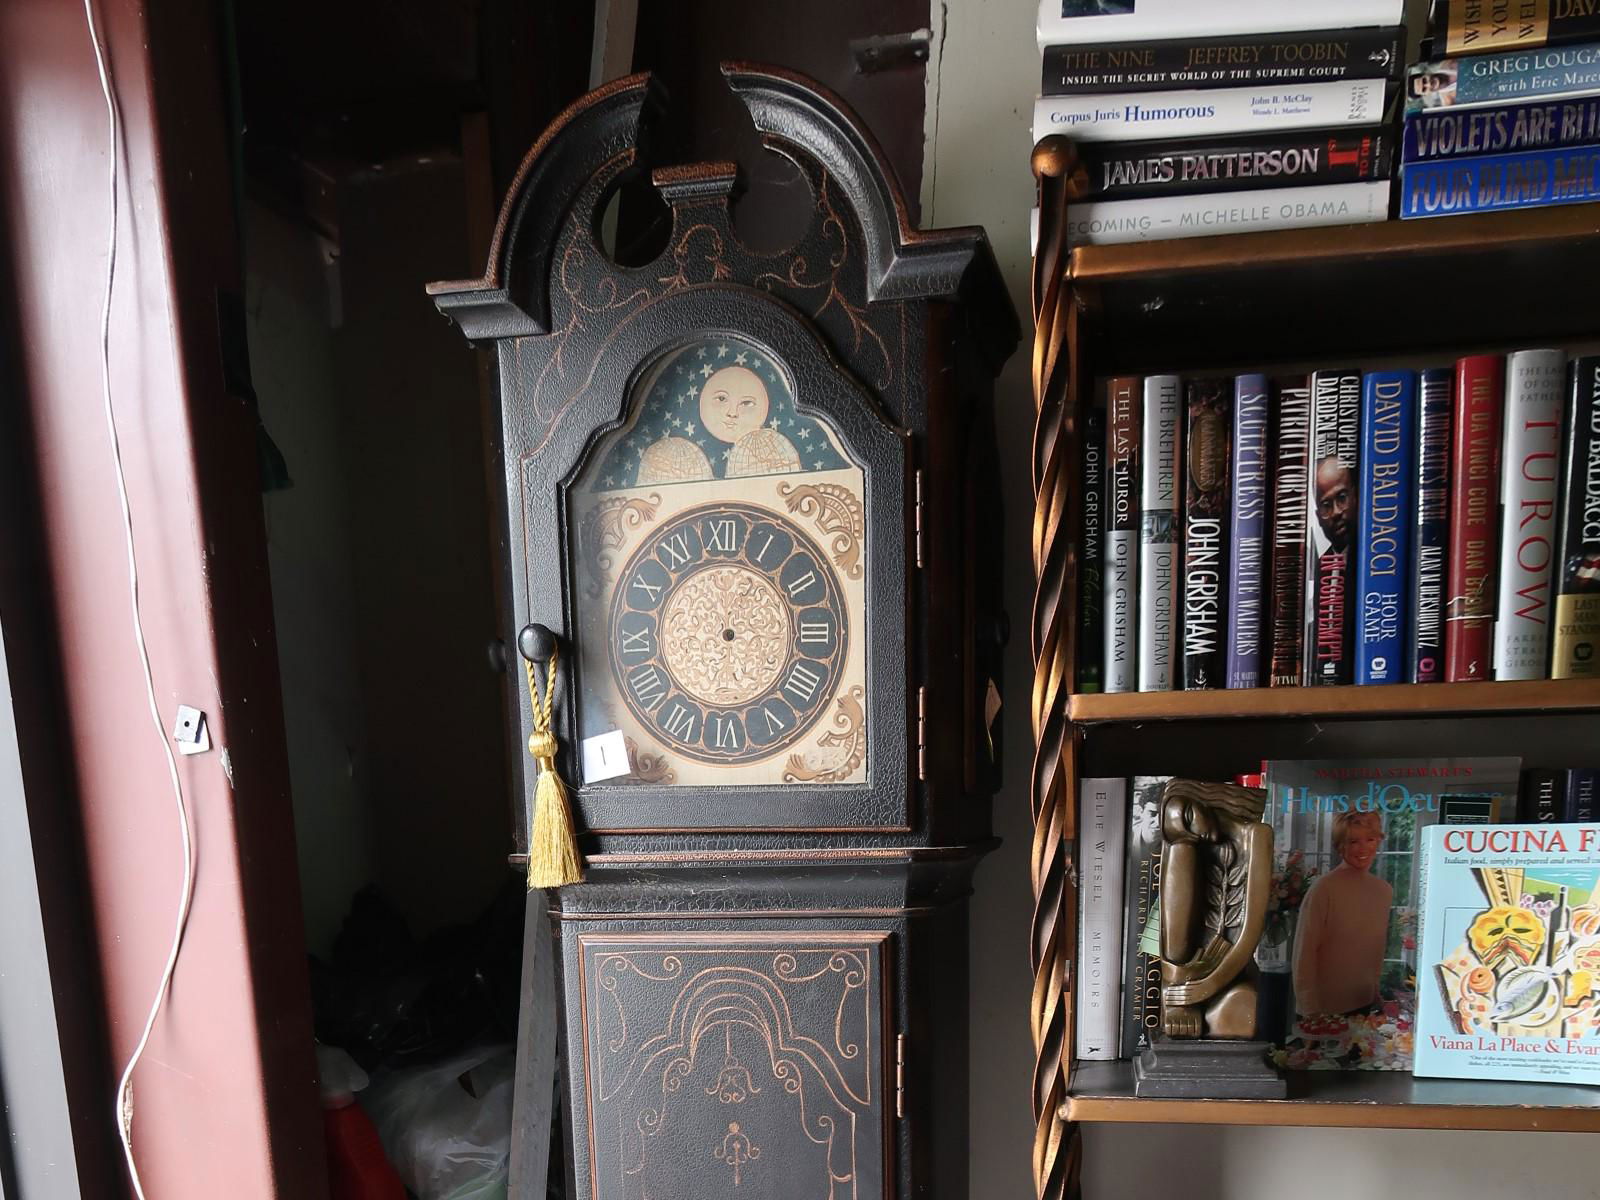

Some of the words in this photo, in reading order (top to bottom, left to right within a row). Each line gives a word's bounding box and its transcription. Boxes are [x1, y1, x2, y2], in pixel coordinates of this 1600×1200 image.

[1492, 0, 1508, 36] YOU
[1062, 52, 1100, 69] THE
[1107, 50, 1155, 69] NINE
[1184, 46, 1265, 70] JEFFREY
[1271, 42, 1348, 63] TOOBIN
[1062, 75, 1098, 85] INSIDE
[1103, 75, 1123, 83] THE
[1127, 73, 1166, 83] SECRET
[1170, 71, 1208, 81] WORLD
[1212, 70, 1226, 80] OF
[1229, 69, 1251, 78] THE
[1255, 67, 1305, 78] SUPREME
[1309, 66, 1346, 76] COURT
[1473, 59, 1528, 77] GREG
[1250, 96, 1270, 106] John
[1283, 94, 1313, 106] McClay
[1498, 79, 1527, 93] with
[1532, 75, 1558, 89] Eric
[1051, 111, 1091, 124] Corpus
[1093, 107, 1120, 123] Juris
[1124, 104, 1215, 123] Humorous
[1415, 112, 1508, 156] VIOLETS
[1511, 107, 1557, 147] ARE
[1102, 157, 1175, 191] JAMES
[1181, 147, 1320, 181] PATTERSON
[1411, 168, 1473, 213] FOUR
[1476, 160, 1549, 207] BLIND
[1068, 215, 1152, 234] ECOMING
[1180, 207, 1270, 227] MICHELLE
[1280, 201, 1349, 219] OBAMA
[1118, 387, 1131, 422] THE
[1160, 382, 1177, 414] THE
[1316, 376, 1339, 432] DARDEN
[1472, 377, 1491, 405] THE
[1279, 388, 1311, 460] PATRICIA
[1337, 376, 1360, 469] CHRISTOPHER
[1373, 381, 1402, 454] DAVID
[1471, 412, 1489, 433] DA
[1086, 443, 1099, 484] JOHN
[1117, 428, 1130, 464] LAST
[1158, 418, 1176, 501] BRETHREN
[1238, 393, 1267, 520] SCULPTRESS
[1469, 436, 1489, 480] VINCI
[1116, 470, 1129, 524] JUROR
[1275, 464, 1308, 548] CORNWELL
[1467, 488, 1487, 526] CODE
[705, 518, 737, 552] XII
[1085, 492, 1099, 559] GRISHAM
[1370, 462, 1400, 577] BALDACCI
[1514, 420, 1559, 625] TUROW
[661, 530, 690, 570] XI
[755, 533, 775, 562] I
[1115, 538, 1128, 581] JOHN
[1187, 516, 1221, 567] JOHN
[1420, 546, 1442, 571] ALAN
[1466, 540, 1486, 571] DAN
[1154, 551, 1171, 591] JOHN
[1238, 537, 1262, 595] MINETTE
[1320, 553, 1346, 571] IN
[633, 574, 662, 602] X
[788, 570, 816, 599] II
[1464, 577, 1484, 629] BROWN
[800, 622, 830, 645] III
[1114, 588, 1127, 663] GRISHAM
[1154, 596, 1171, 667] GRISHAM
[1185, 571, 1219, 657] GRISHAM
[1236, 599, 1261, 656] WALTERS
[1317, 575, 1345, 662] CONTEMPT
[1364, 592, 1382, 644] GAME
[1380, 593, 1398, 641] HOUR
[622, 627, 650, 654] IX
[630, 668, 662, 710] VIII
[784, 663, 820, 701] IIII
[664, 704, 694, 744] VII
[715, 717, 739, 748] VI
[762, 710, 785, 736] V
[1095, 791, 1107, 833] ELIE
[1282, 785, 1350, 815] Hors
[1538, 779, 1554, 807] THE
[1443, 830, 1569, 853] CUCINA
[1444, 856, 1469, 865] Italian
[1515, 857, 1546, 867] prepared
[1548, 856, 1565, 865] and
[1093, 839, 1106, 903] WIESEL
[1137, 860, 1149, 924] RICHARD
[1091, 930, 1102, 1009] MEMOIRS
[1132, 966, 1145, 1022] CRAMER
[1429, 1035, 1474, 1051] Viana
[1478, 1036, 1496, 1051] La
[1500, 1037, 1542, 1053] Place
[1544, 1039, 1561, 1054] &
